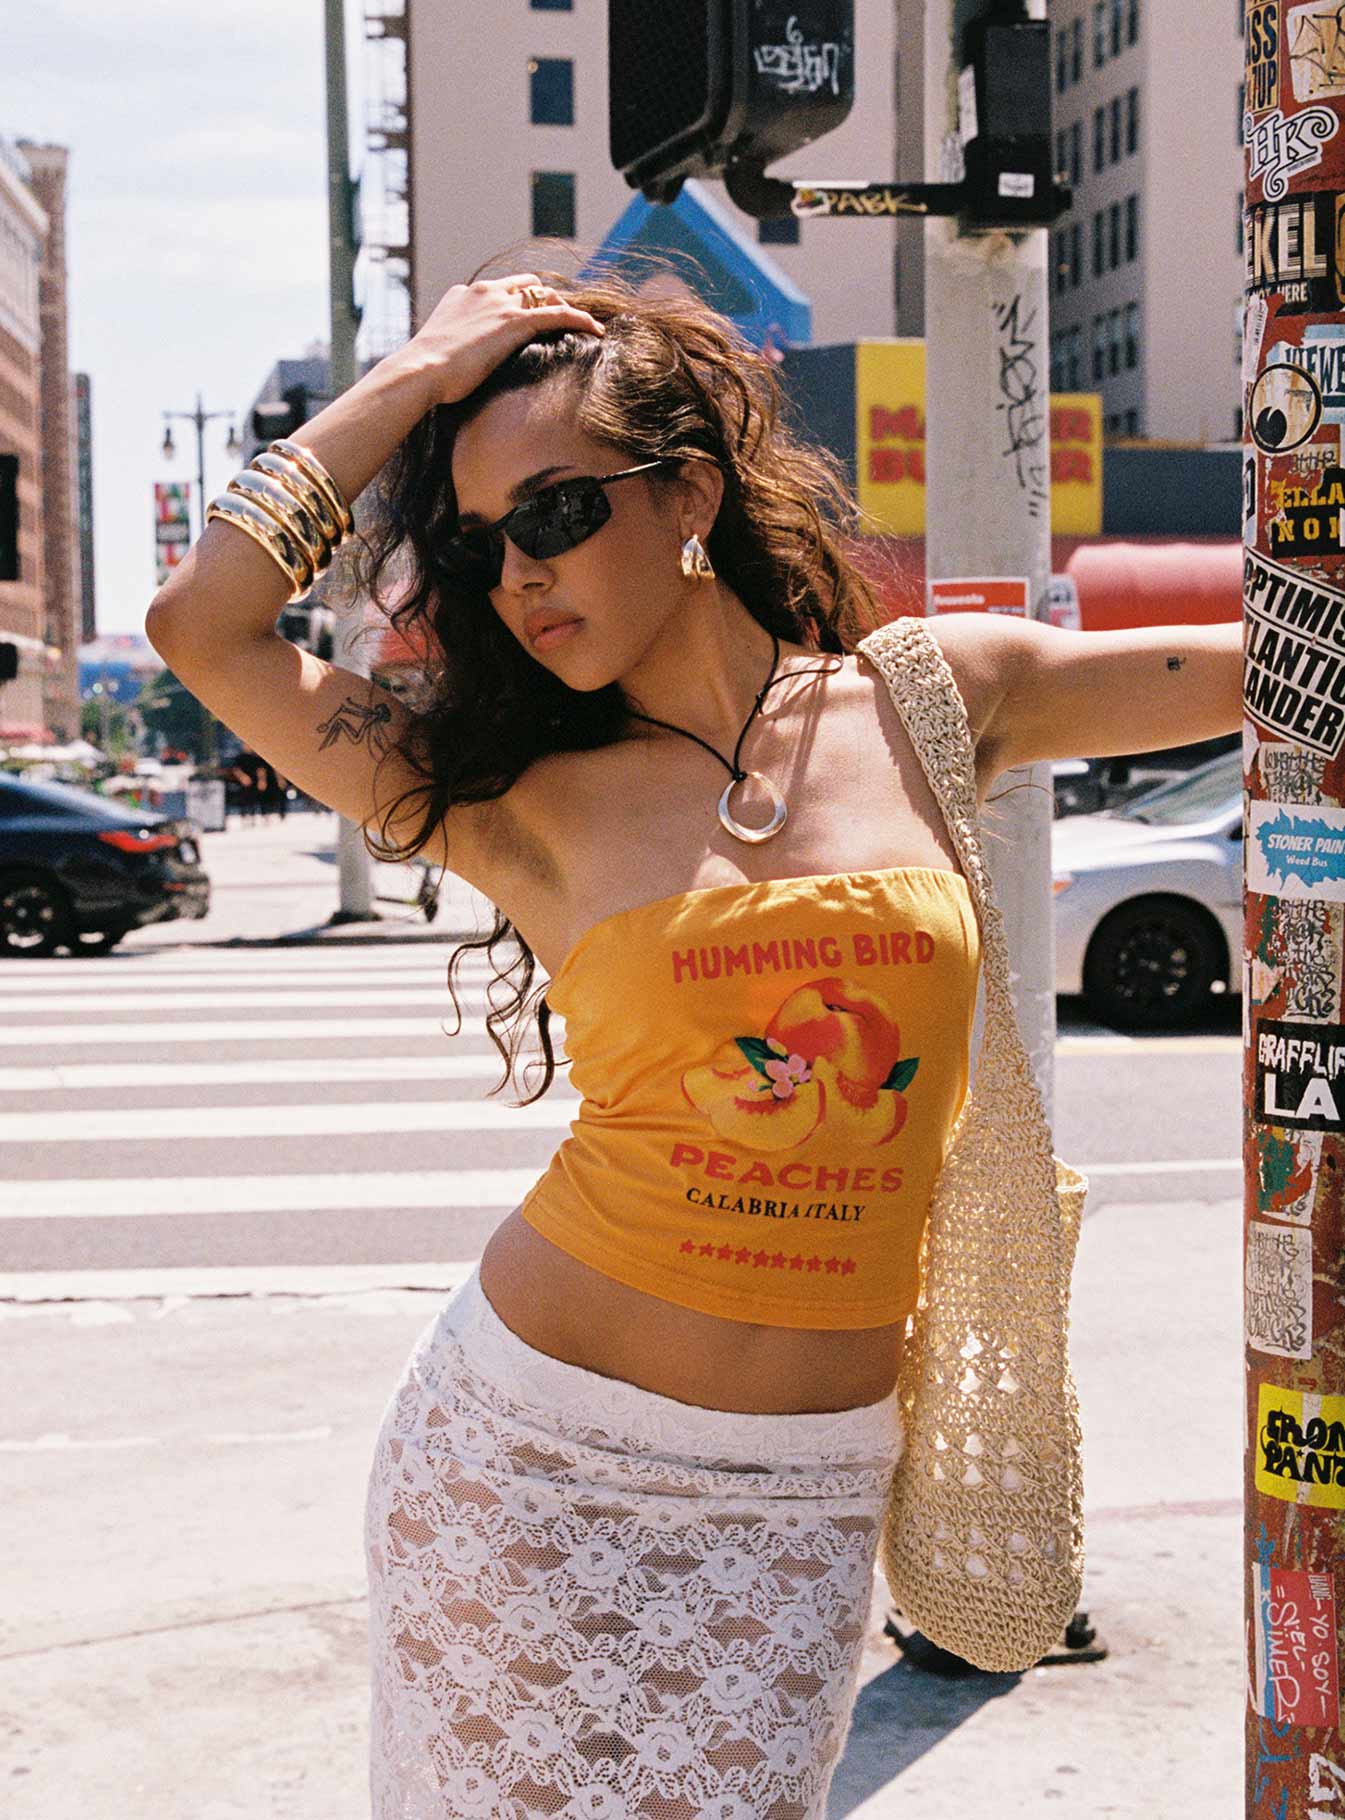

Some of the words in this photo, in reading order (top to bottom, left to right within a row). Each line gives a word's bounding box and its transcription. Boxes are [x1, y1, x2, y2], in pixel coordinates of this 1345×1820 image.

[1267, 834, 1312, 851] STONER
[1315, 837, 1345, 854] PAIN
[672, 936, 842, 984] HUMMING
[852, 931, 936, 966] BIRD
[1264, 1073, 1340, 1121] LA
[670, 1143, 905, 1193] PEACHES
[686, 1187, 799, 1218] CALABRIA
[804, 1203, 866, 1222] ITALY
[1311, 1651, 1331, 1696] SOY
